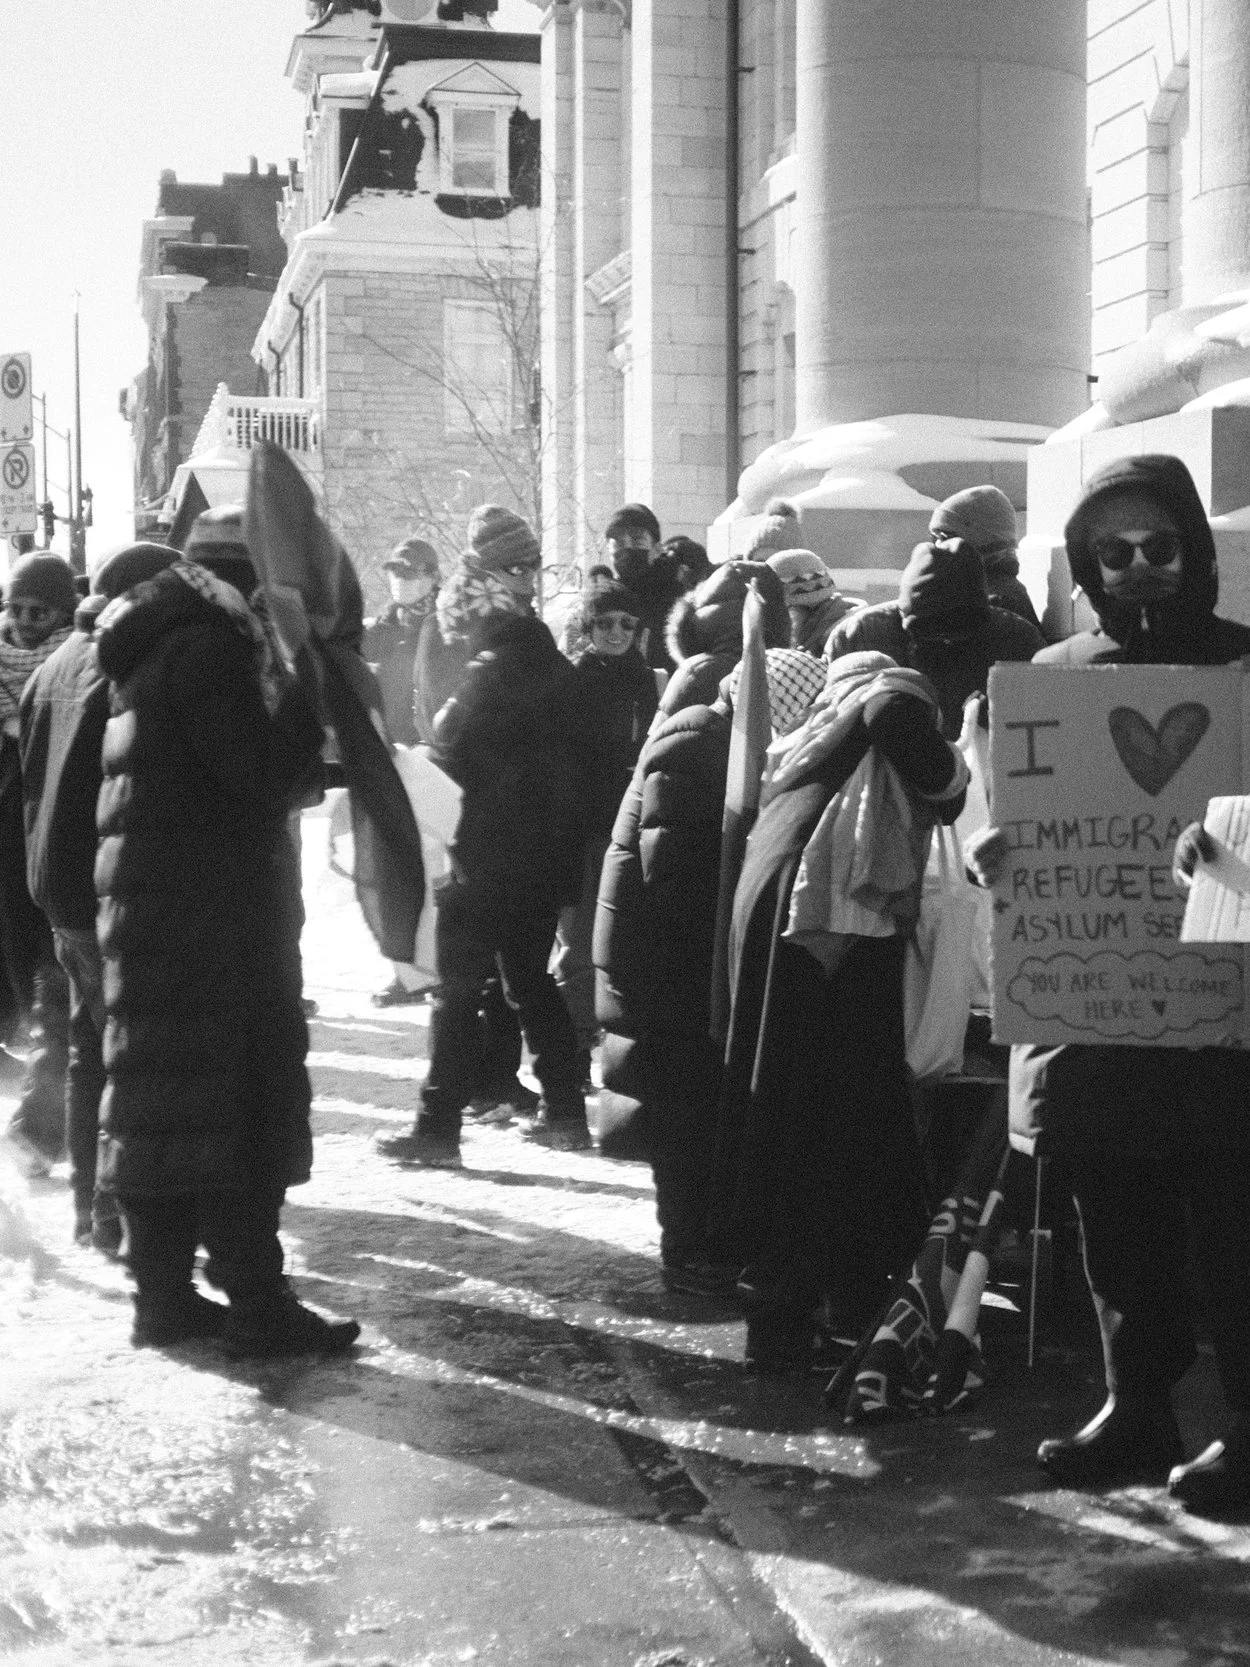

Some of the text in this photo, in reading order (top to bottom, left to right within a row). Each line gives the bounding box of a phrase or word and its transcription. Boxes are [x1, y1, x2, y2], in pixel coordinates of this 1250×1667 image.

[1004, 719, 1060, 778] I
[1003, 812, 1193, 851] IMMIGRA
[1011, 911, 1128, 942] ASYLUM
[1026, 971, 1231, 997] YOU ARE WELCOME
[1084, 999, 1143, 1020] HERE
